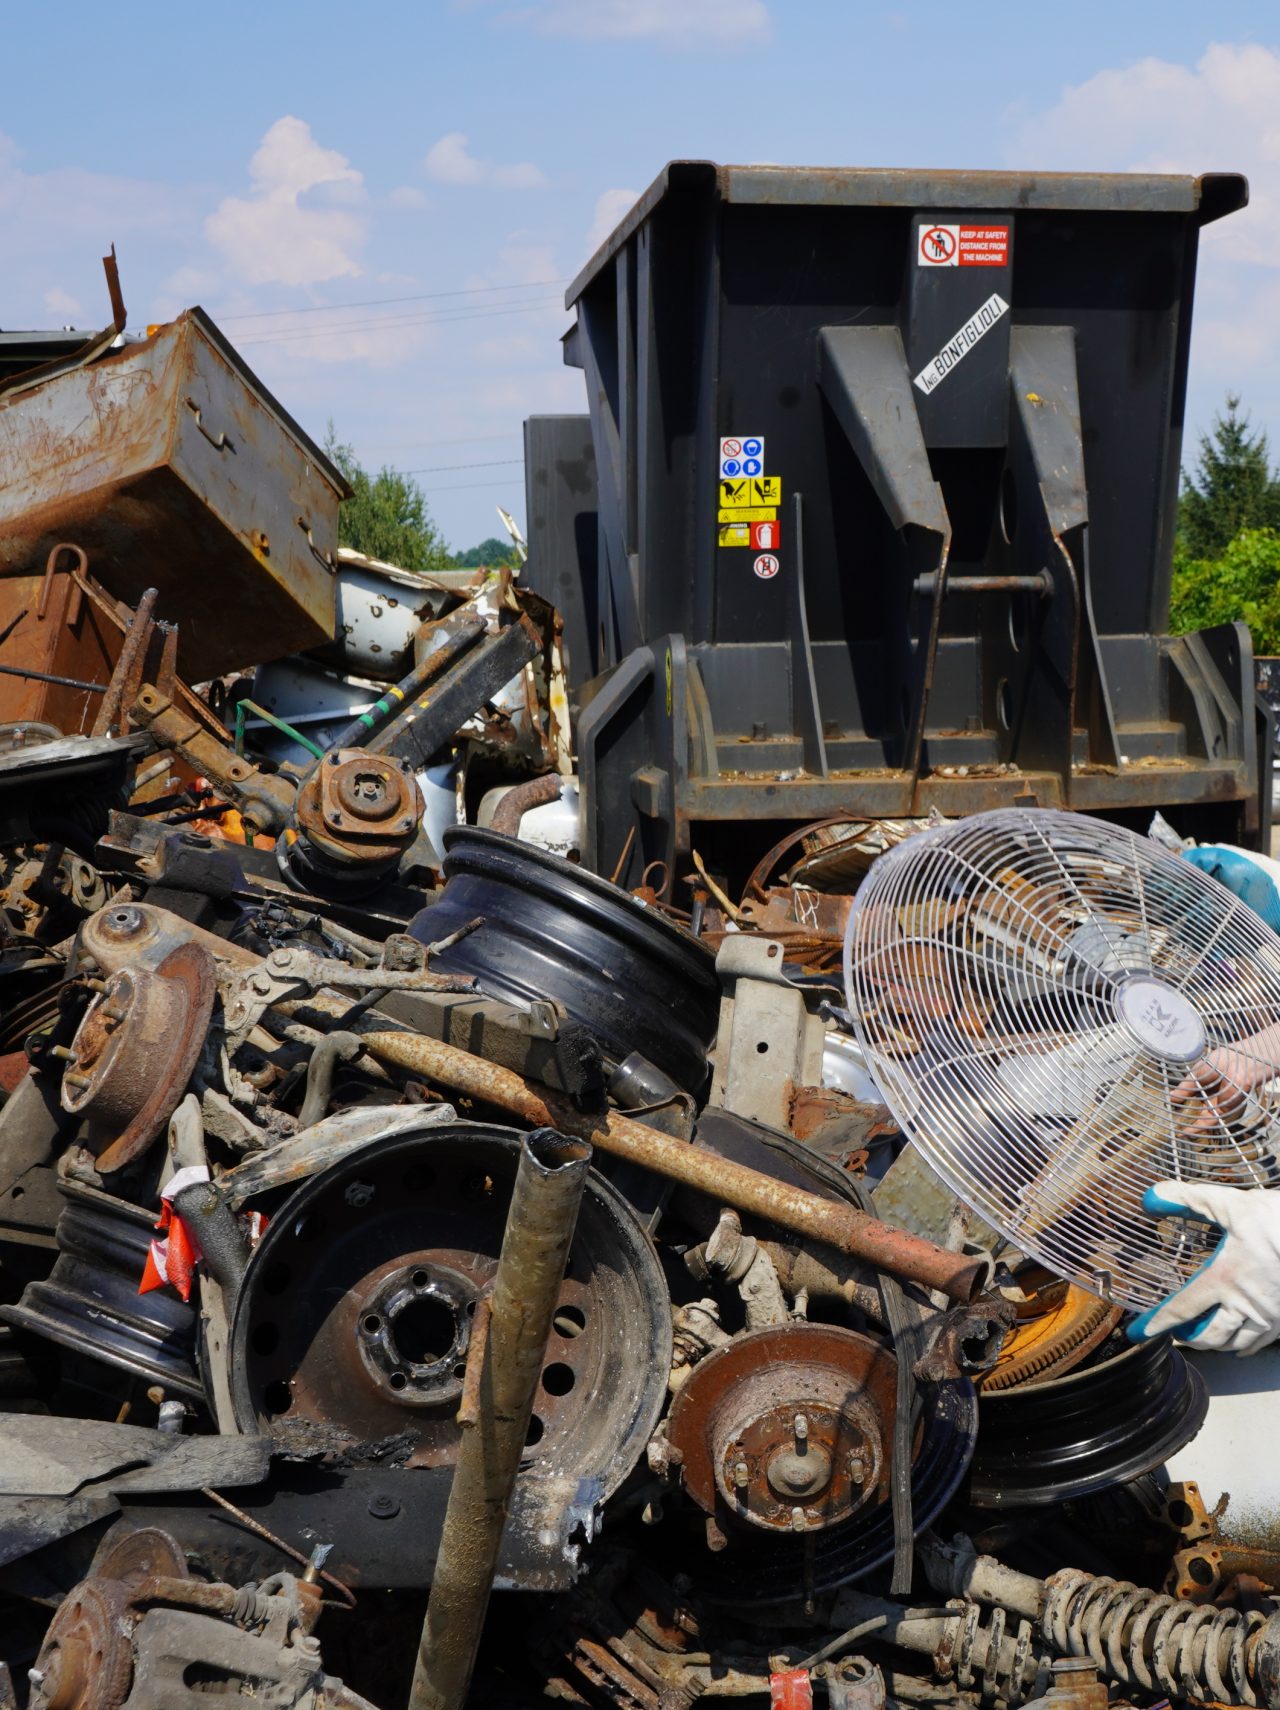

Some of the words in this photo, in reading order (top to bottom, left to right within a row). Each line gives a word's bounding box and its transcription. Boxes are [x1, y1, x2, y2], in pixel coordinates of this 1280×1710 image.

[960, 231, 976, 239] KEEP
[976, 231, 985, 239] AT
[985, 231, 1007, 239] SAFETY
[960, 242, 988, 250] DISTANCE
[989, 242, 1006, 250] FROM
[963, 253, 975, 261] THE
[975, 253, 1003, 261] MACHINE
[934, 298, 1001, 377] BONFIGLIOLI
